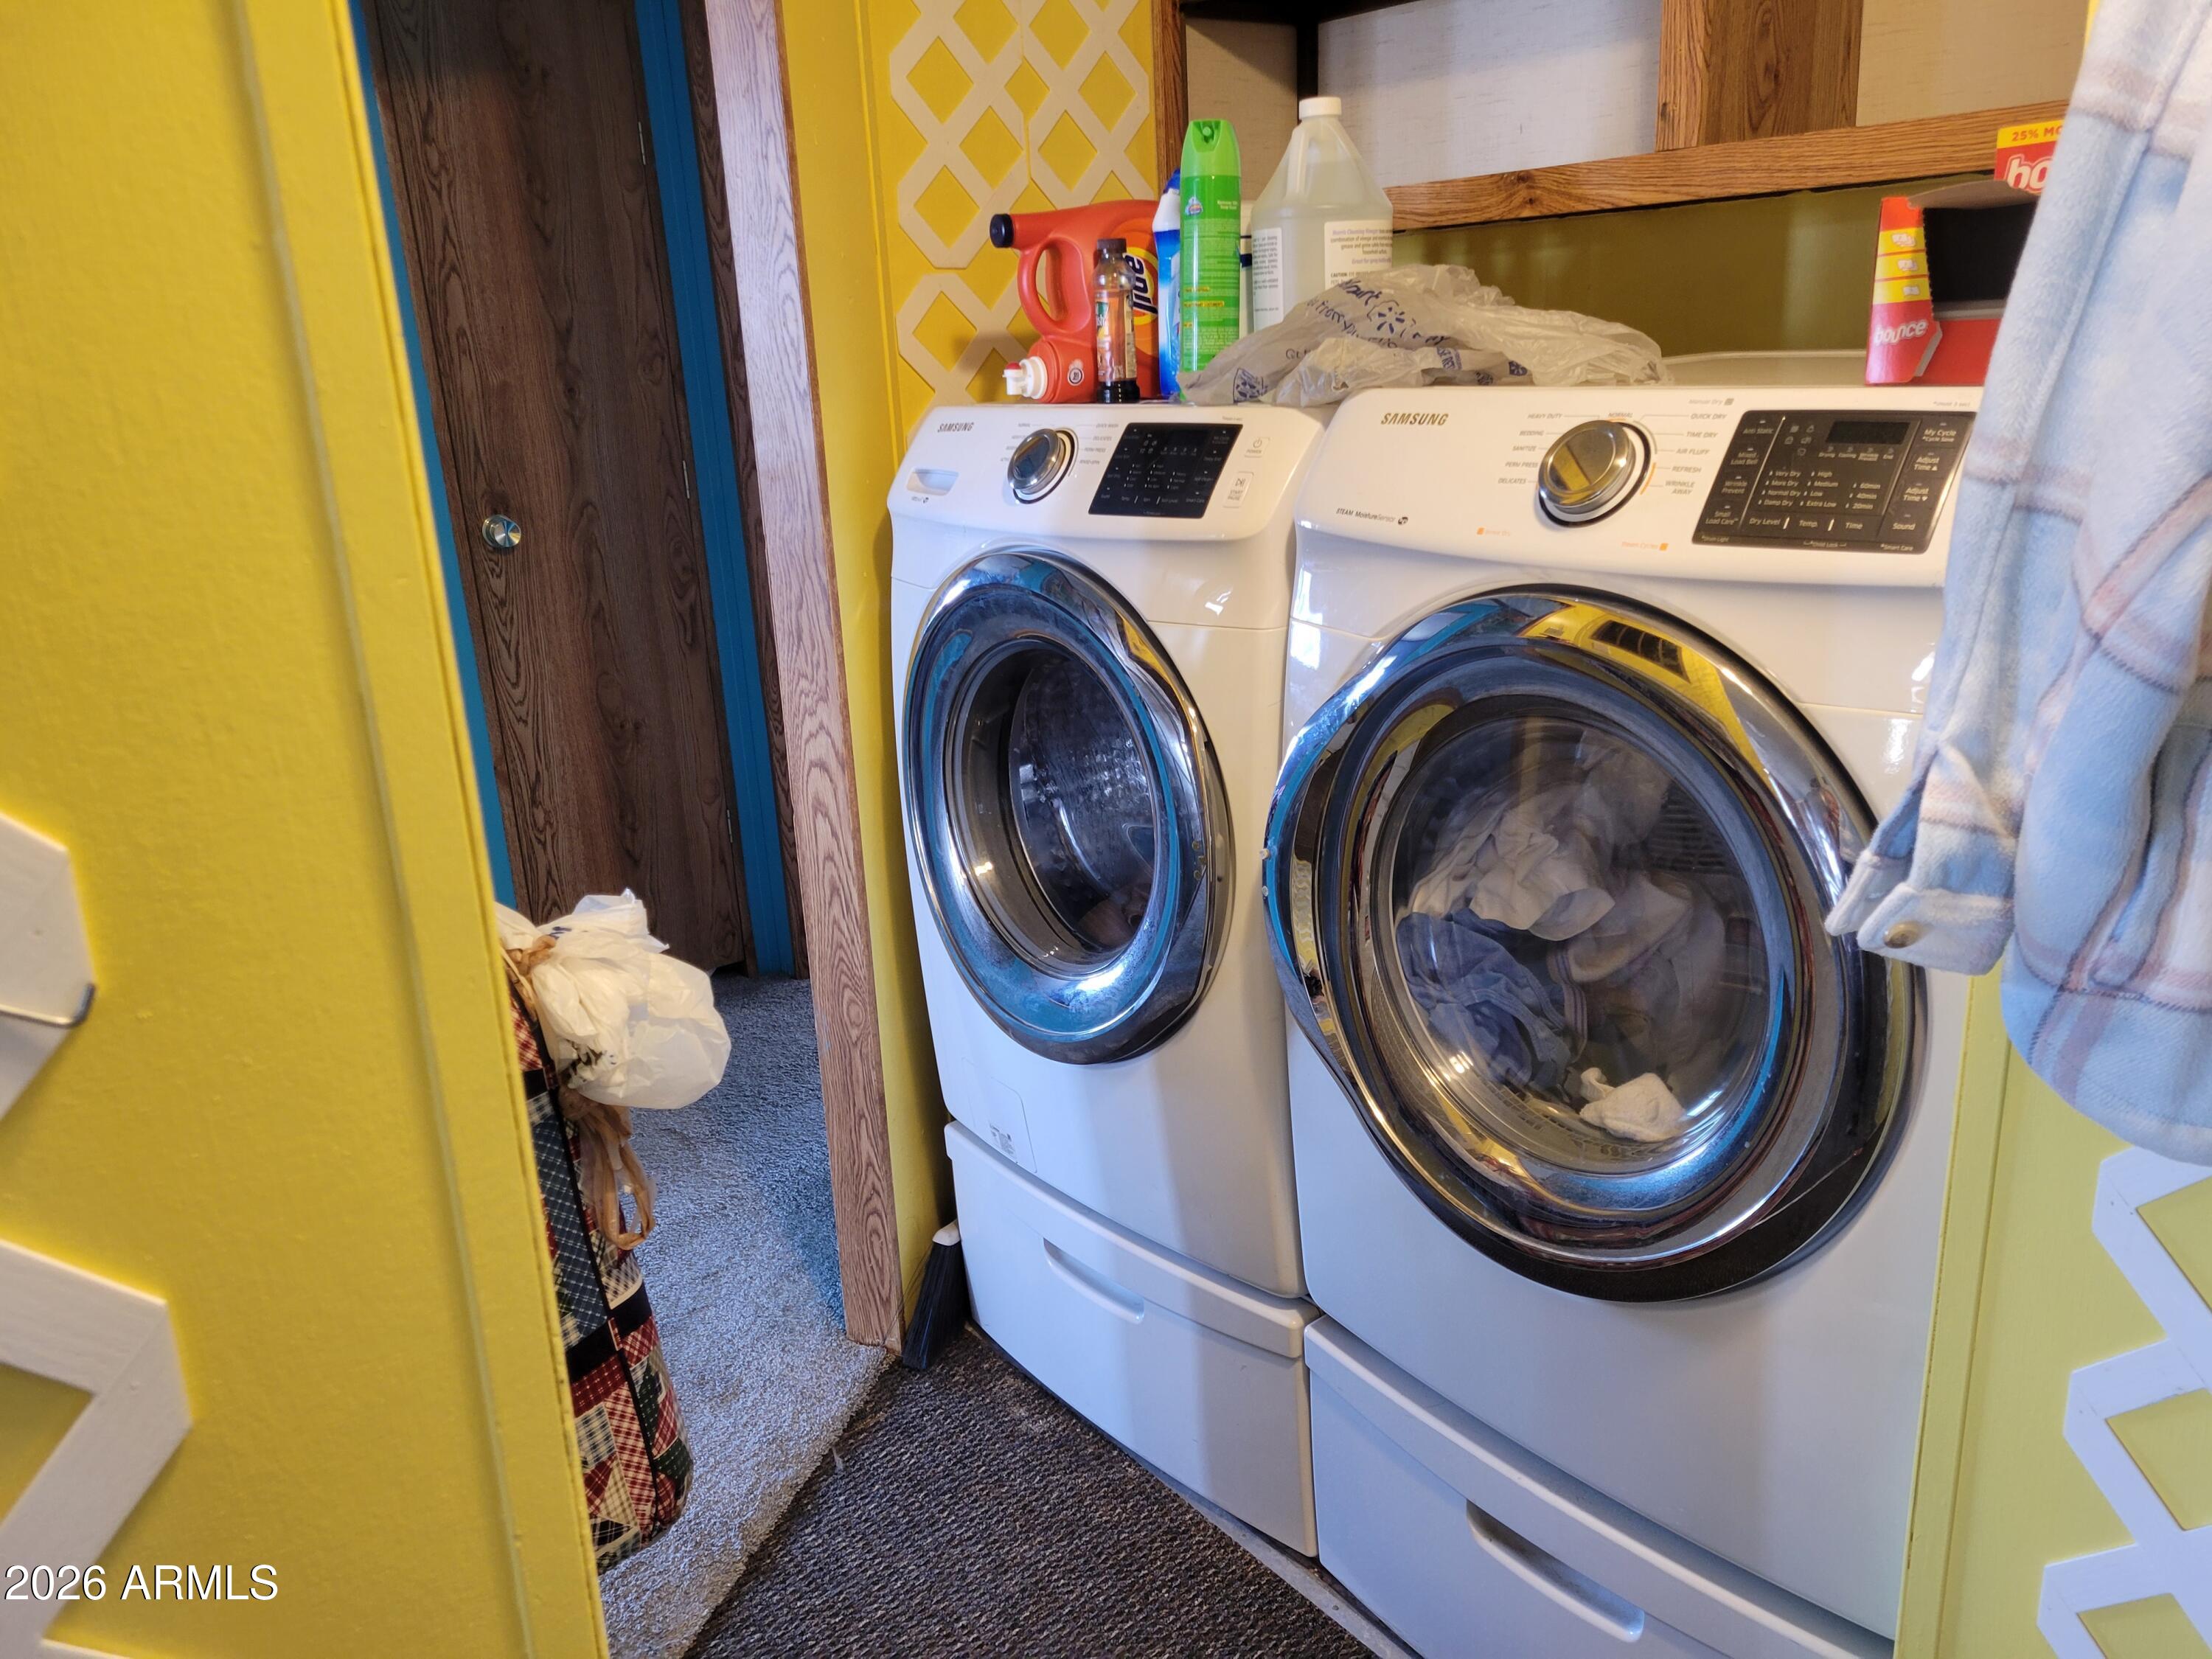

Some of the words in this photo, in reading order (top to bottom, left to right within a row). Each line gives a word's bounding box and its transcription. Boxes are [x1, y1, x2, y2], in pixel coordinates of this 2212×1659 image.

[2011, 128, 2039, 142] 25%
[2044, 125, 2063, 137] MO
[1874, 319, 1928, 347] bounce
[1380, 412, 1449, 425] SAMSUNG
[937, 422, 975, 433] SAMSUNG
[1916, 456, 1940, 465] Adjust
[1905, 487, 1930, 495] Adjust
[1335, 507, 1354, 516] STEAM
[1749, 518, 1761, 526] Dry
[1846, 521, 1864, 530] Time
[1892, 522, 1916, 531] Sound
